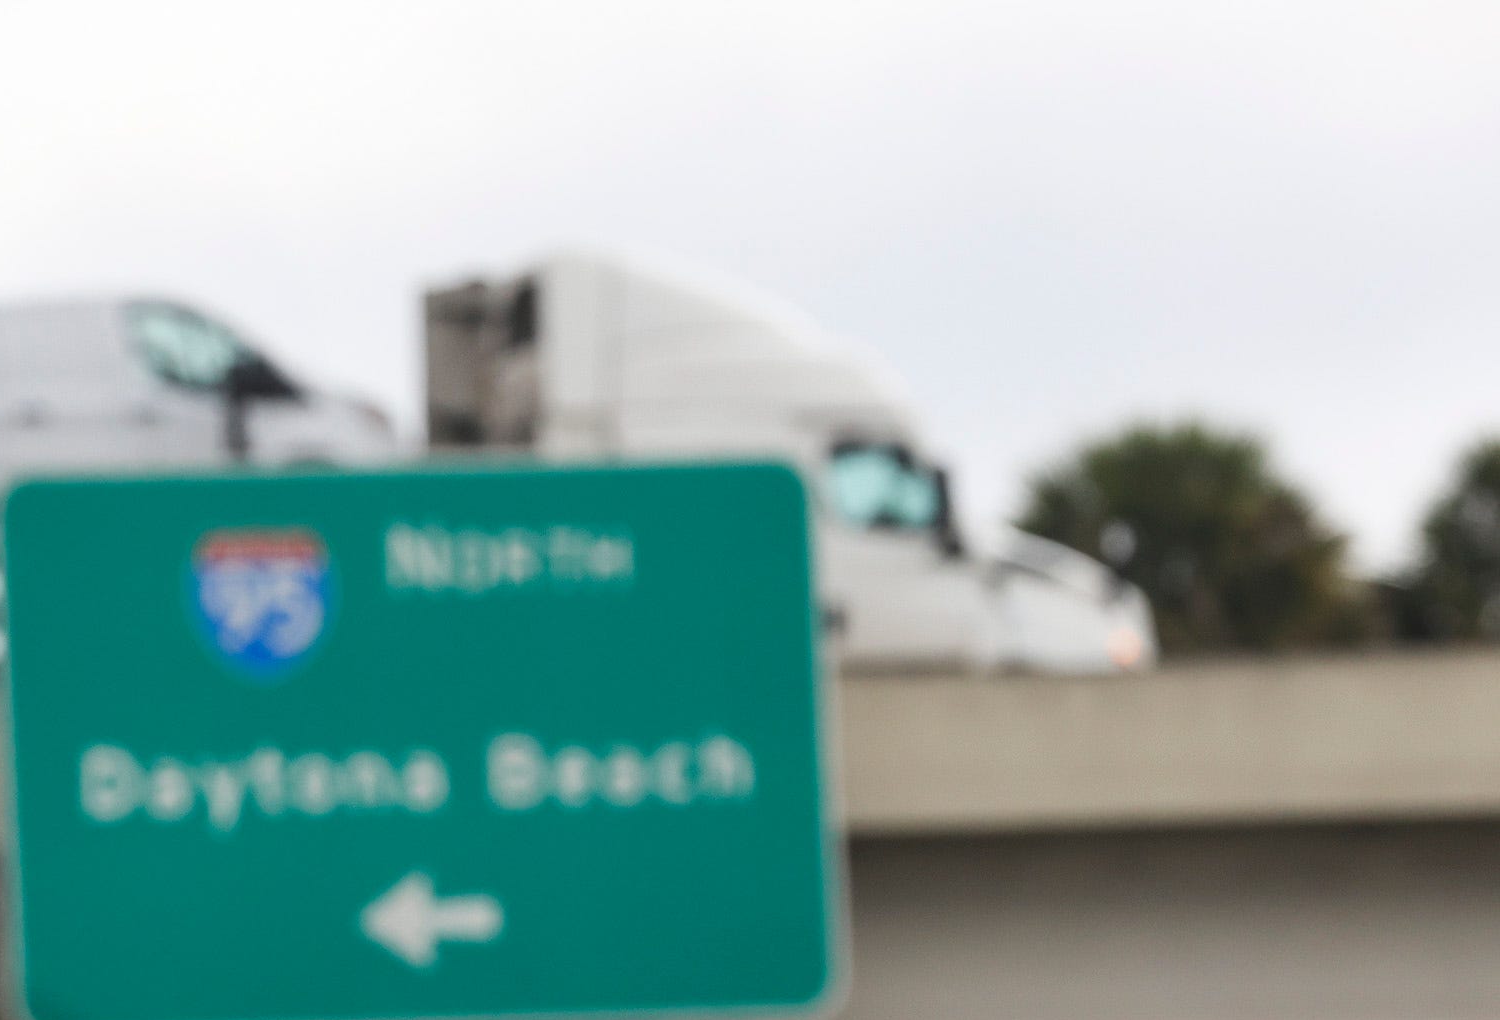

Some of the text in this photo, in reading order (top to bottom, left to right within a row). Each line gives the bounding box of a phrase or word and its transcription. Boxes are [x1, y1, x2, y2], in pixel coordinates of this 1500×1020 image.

[383, 522, 635, 592] NORTH
[200, 566, 325, 659] 95
[80, 732, 756, 831] Daytona Beach
